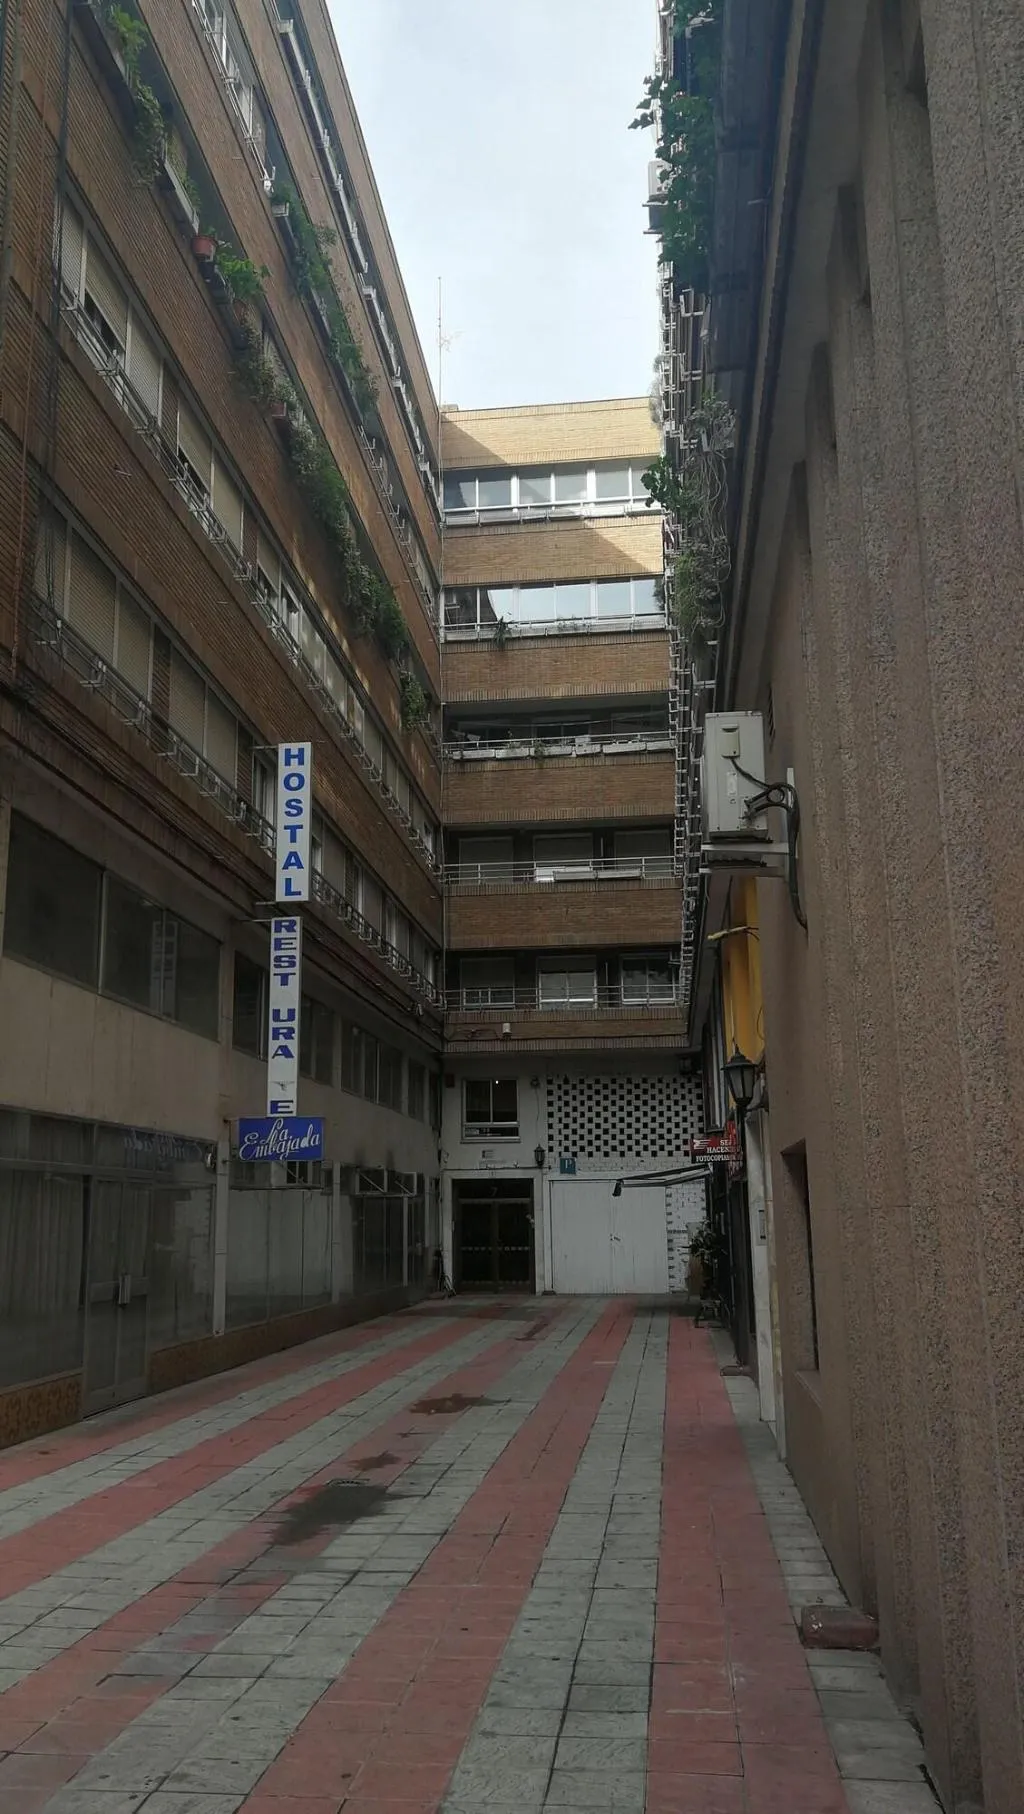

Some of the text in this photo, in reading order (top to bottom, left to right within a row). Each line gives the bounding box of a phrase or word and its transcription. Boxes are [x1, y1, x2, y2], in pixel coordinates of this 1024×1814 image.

[282, 747, 305, 897] HOSTAL
[239, 1123, 320, 1161] Embajada
[260, 1118, 289, 1145] La
